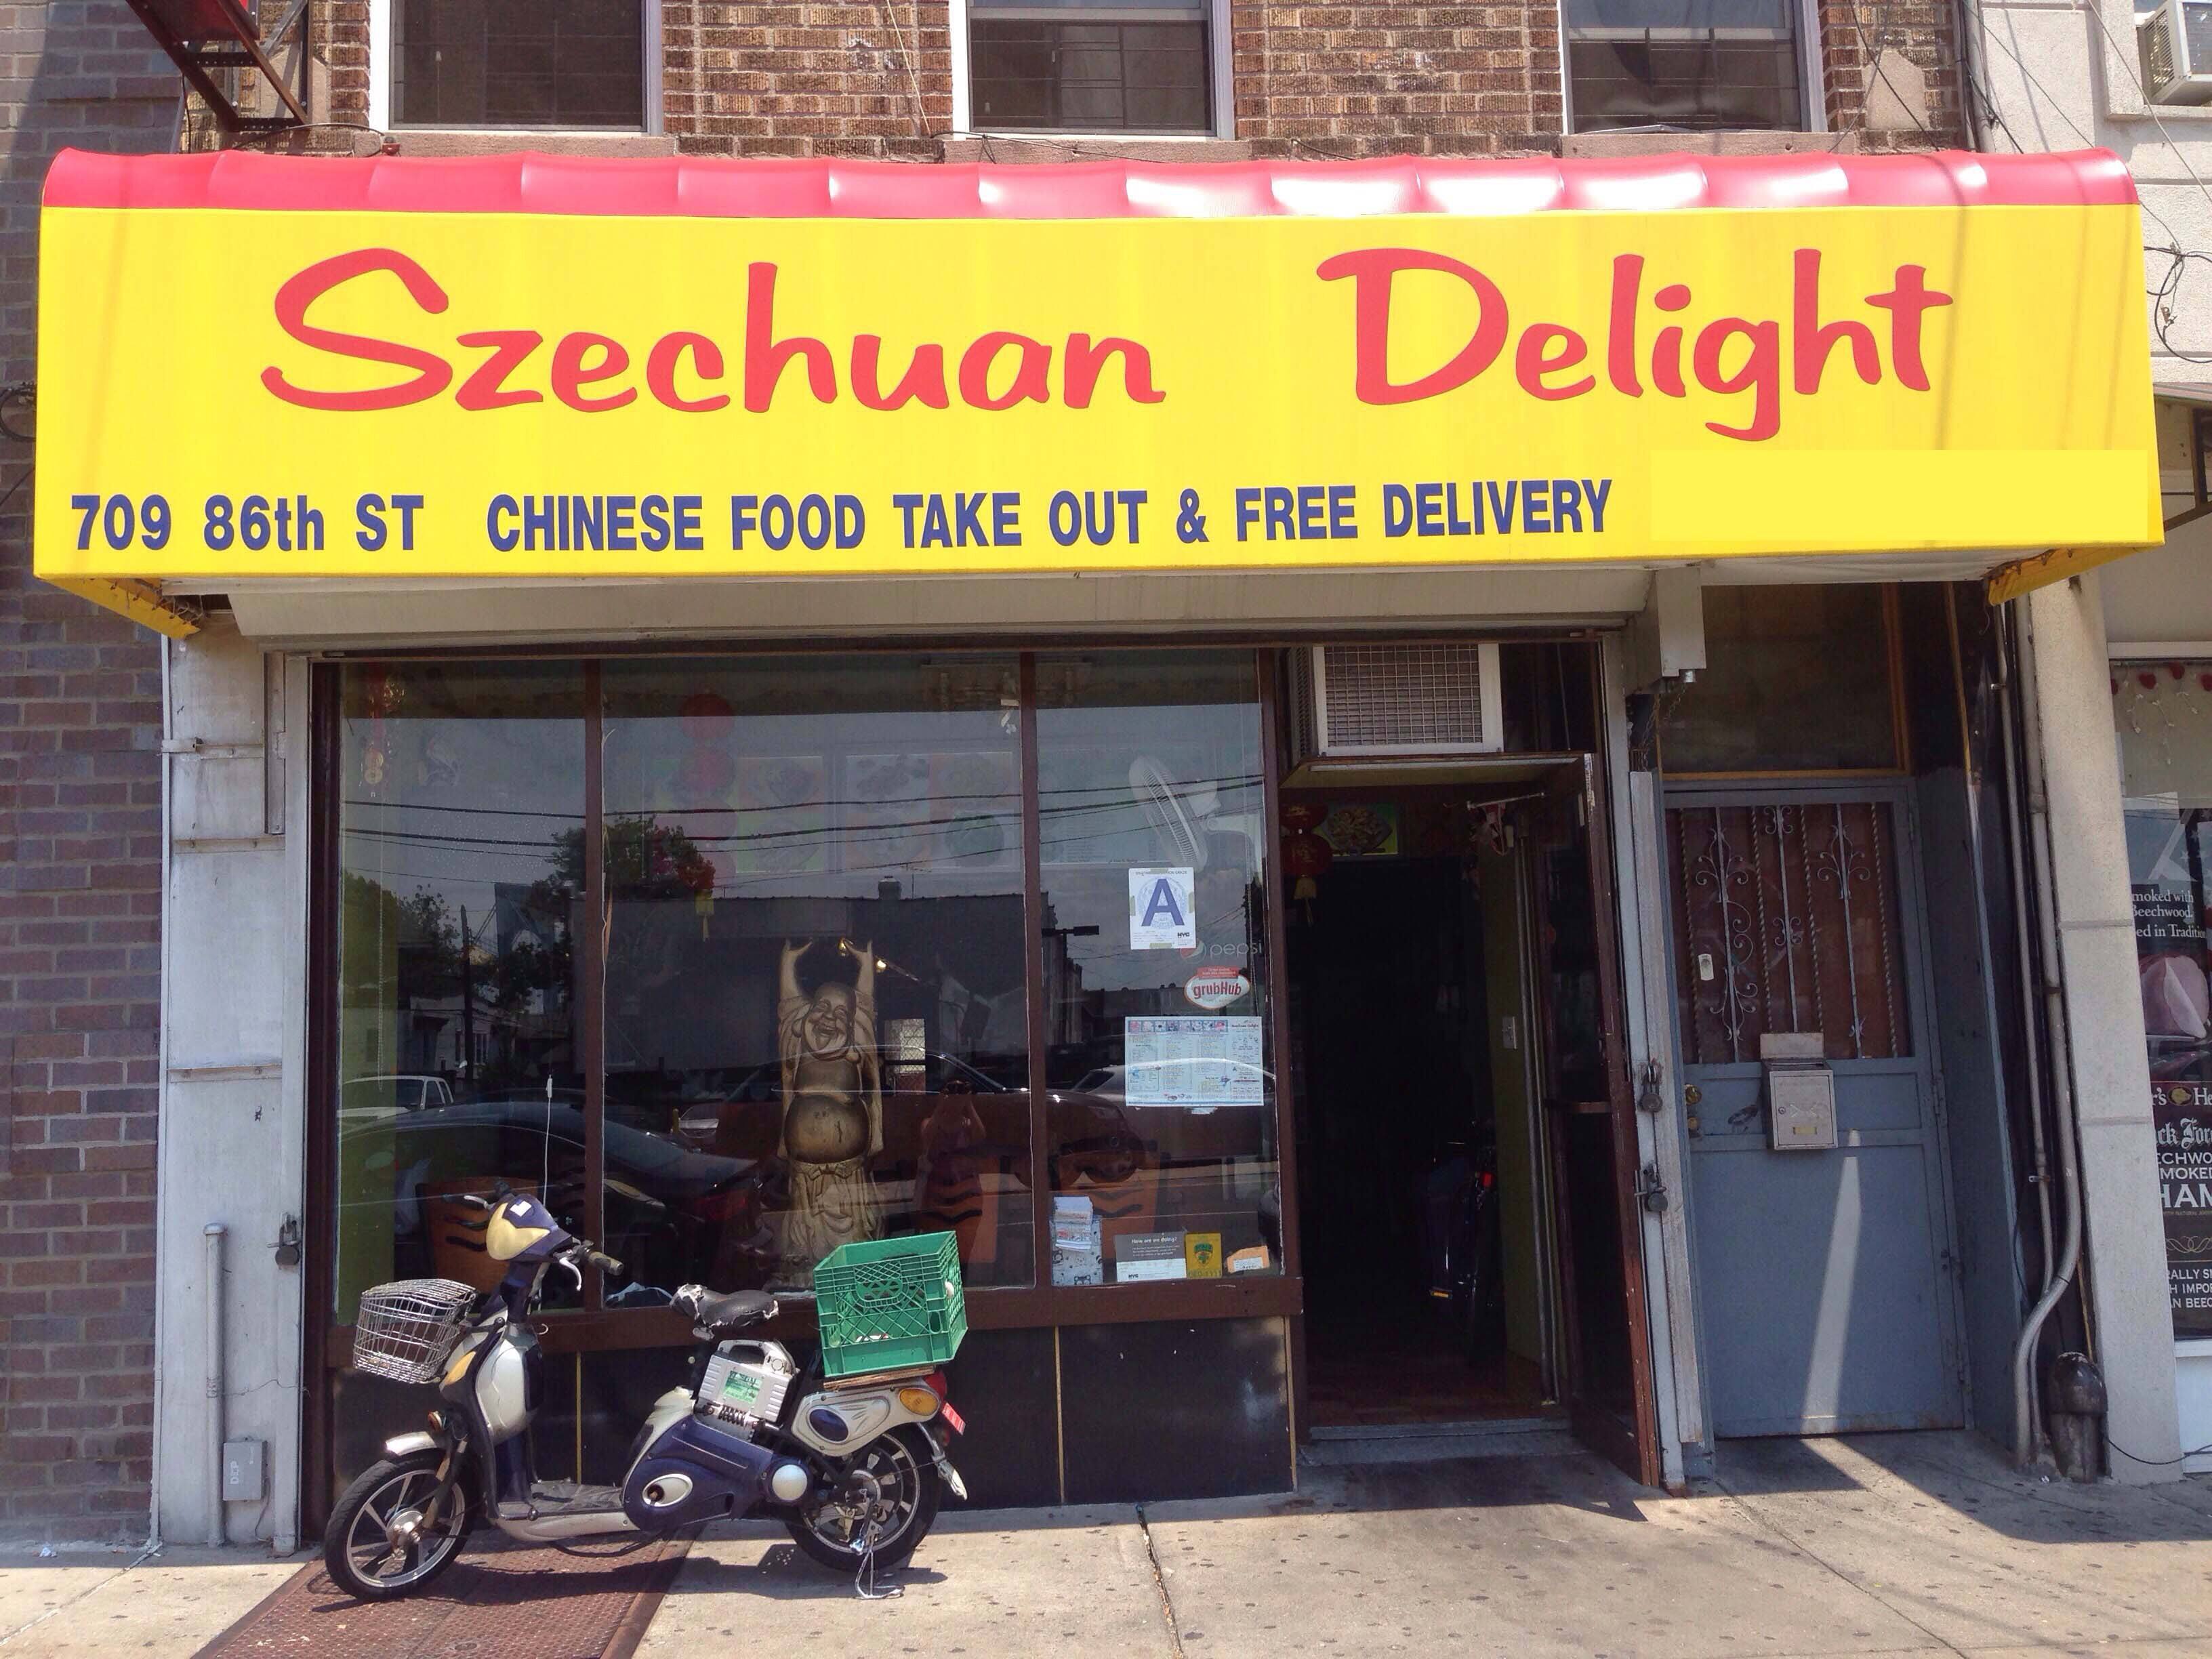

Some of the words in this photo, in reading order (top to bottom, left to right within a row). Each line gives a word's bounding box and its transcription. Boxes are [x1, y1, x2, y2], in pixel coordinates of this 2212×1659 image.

[261, 248, 1166, 413] Szechuan
[1317, 248, 1952, 441] Delight
[72, 495, 171, 550] 709
[204, 495, 323, 551] 86th
[356, 494, 424, 551] ST
[487, 495, 703, 552] CHINESE
[732, 494, 865, 550] FOOD
[893, 493, 1021, 548] TAKE
[1049, 491, 1147, 546] OUT
[1176, 489, 1208, 543] &
[1236, 486, 1357, 541] FREE
[1384, 480, 1612, 537] DELIVERY
[1141, 878, 1185, 926] A
[2173, 890, 2194, 903] with
[2154, 924, 2166, 937] in
[1210, 939, 1262, 960] pepsi
[1193, 981, 1242, 999] grubHub
[2180, 1118, 2212, 1149] For
[2182, 1283, 2212, 1294] IMPO
[2171, 1298, 2182, 1308] N
